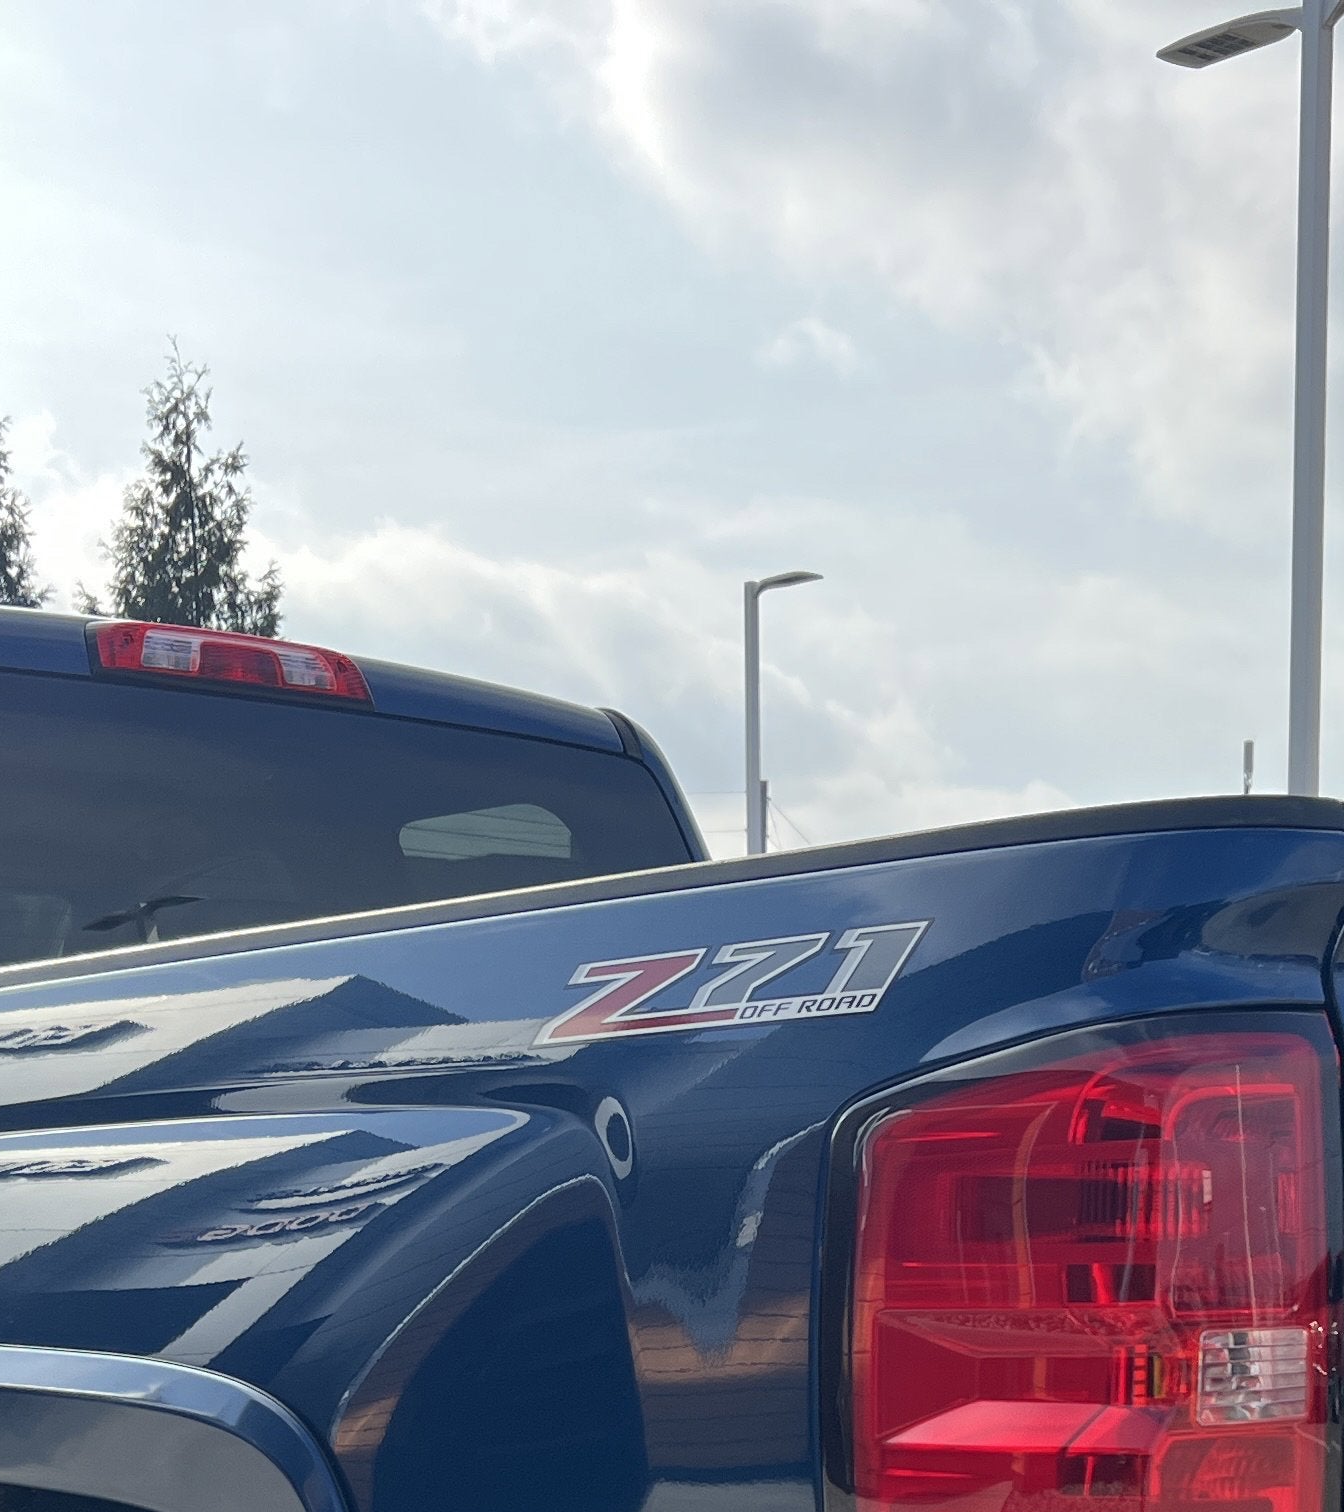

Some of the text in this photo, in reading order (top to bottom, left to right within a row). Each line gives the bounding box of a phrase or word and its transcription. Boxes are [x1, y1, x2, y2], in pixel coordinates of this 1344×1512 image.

[529, 917, 935, 1050] Z71
[739, 993, 879, 1021] OFF ROAD
